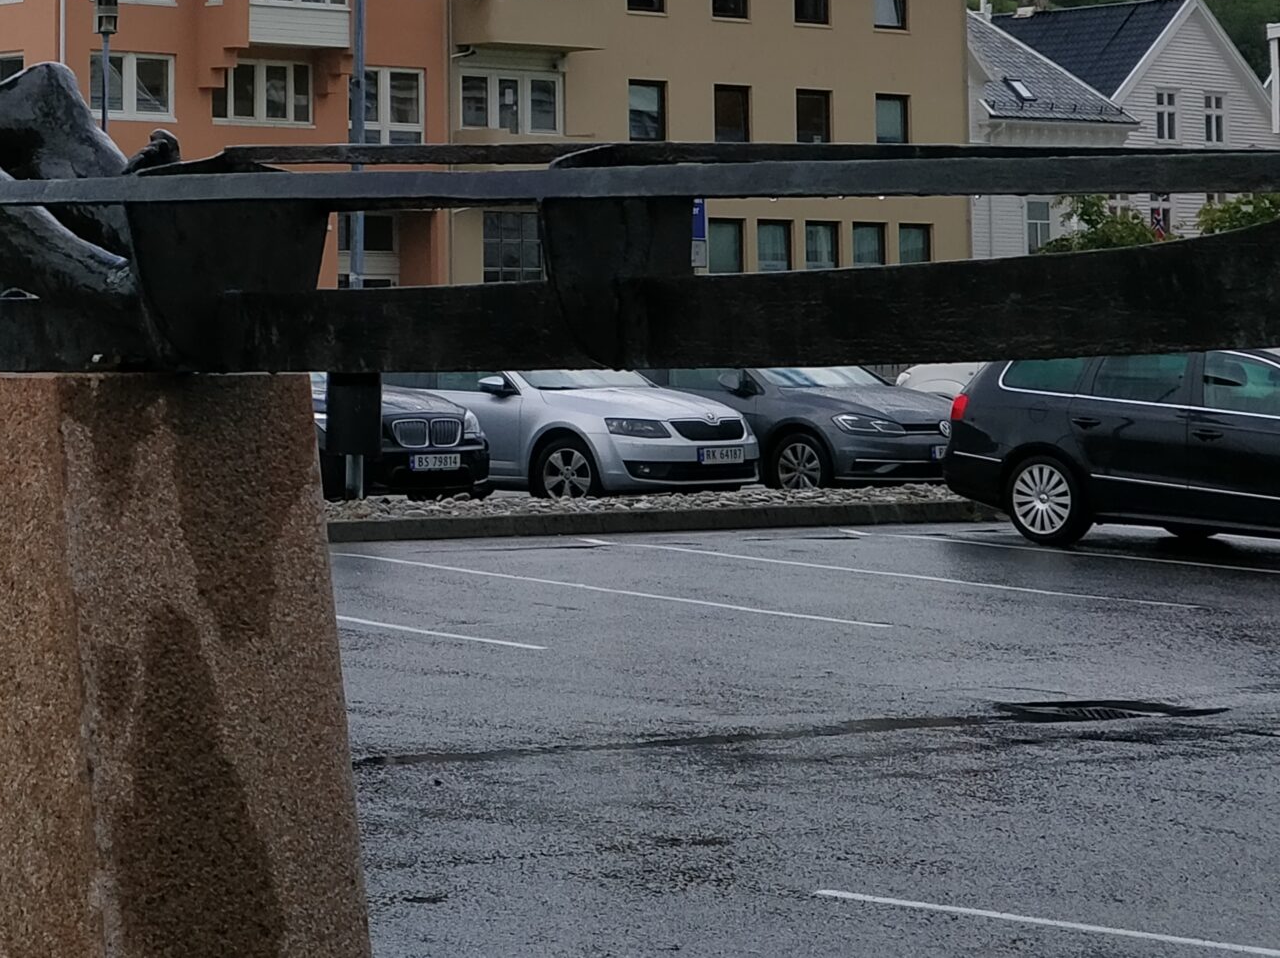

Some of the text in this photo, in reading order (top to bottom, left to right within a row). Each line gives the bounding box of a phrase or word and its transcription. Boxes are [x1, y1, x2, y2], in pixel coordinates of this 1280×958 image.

[706, 448, 742, 460] RK 64187
[417, 455, 458, 468] BS 79814
